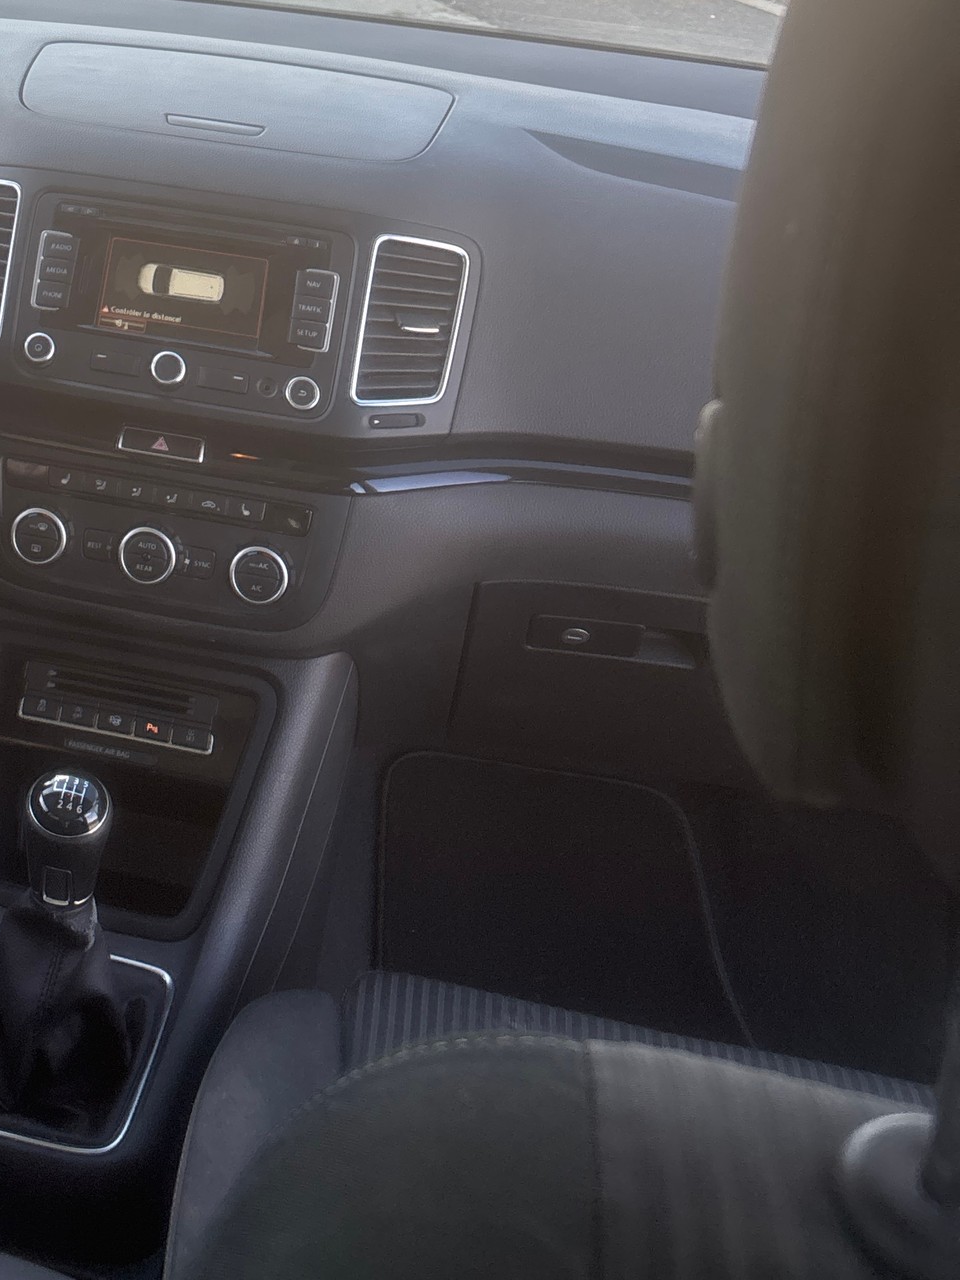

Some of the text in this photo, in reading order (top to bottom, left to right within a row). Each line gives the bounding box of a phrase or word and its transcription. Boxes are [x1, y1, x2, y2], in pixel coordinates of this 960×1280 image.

[50, 242, 73, 252] RADIO
[46, 266, 68, 275] MEDIA
[306, 280, 321, 288] NAV
[42, 290, 63, 299] PHONE
[298, 303, 323, 313] TRAFFIC
[296, 328, 318, 337] SETUP
[87, 541, 101, 550] REST
[138, 541, 157, 550] AUTO
[136, 563, 153, 572] REAR
[194, 560, 212, 569] SYNC
[57, 800, 83, 814] 2 4 6
